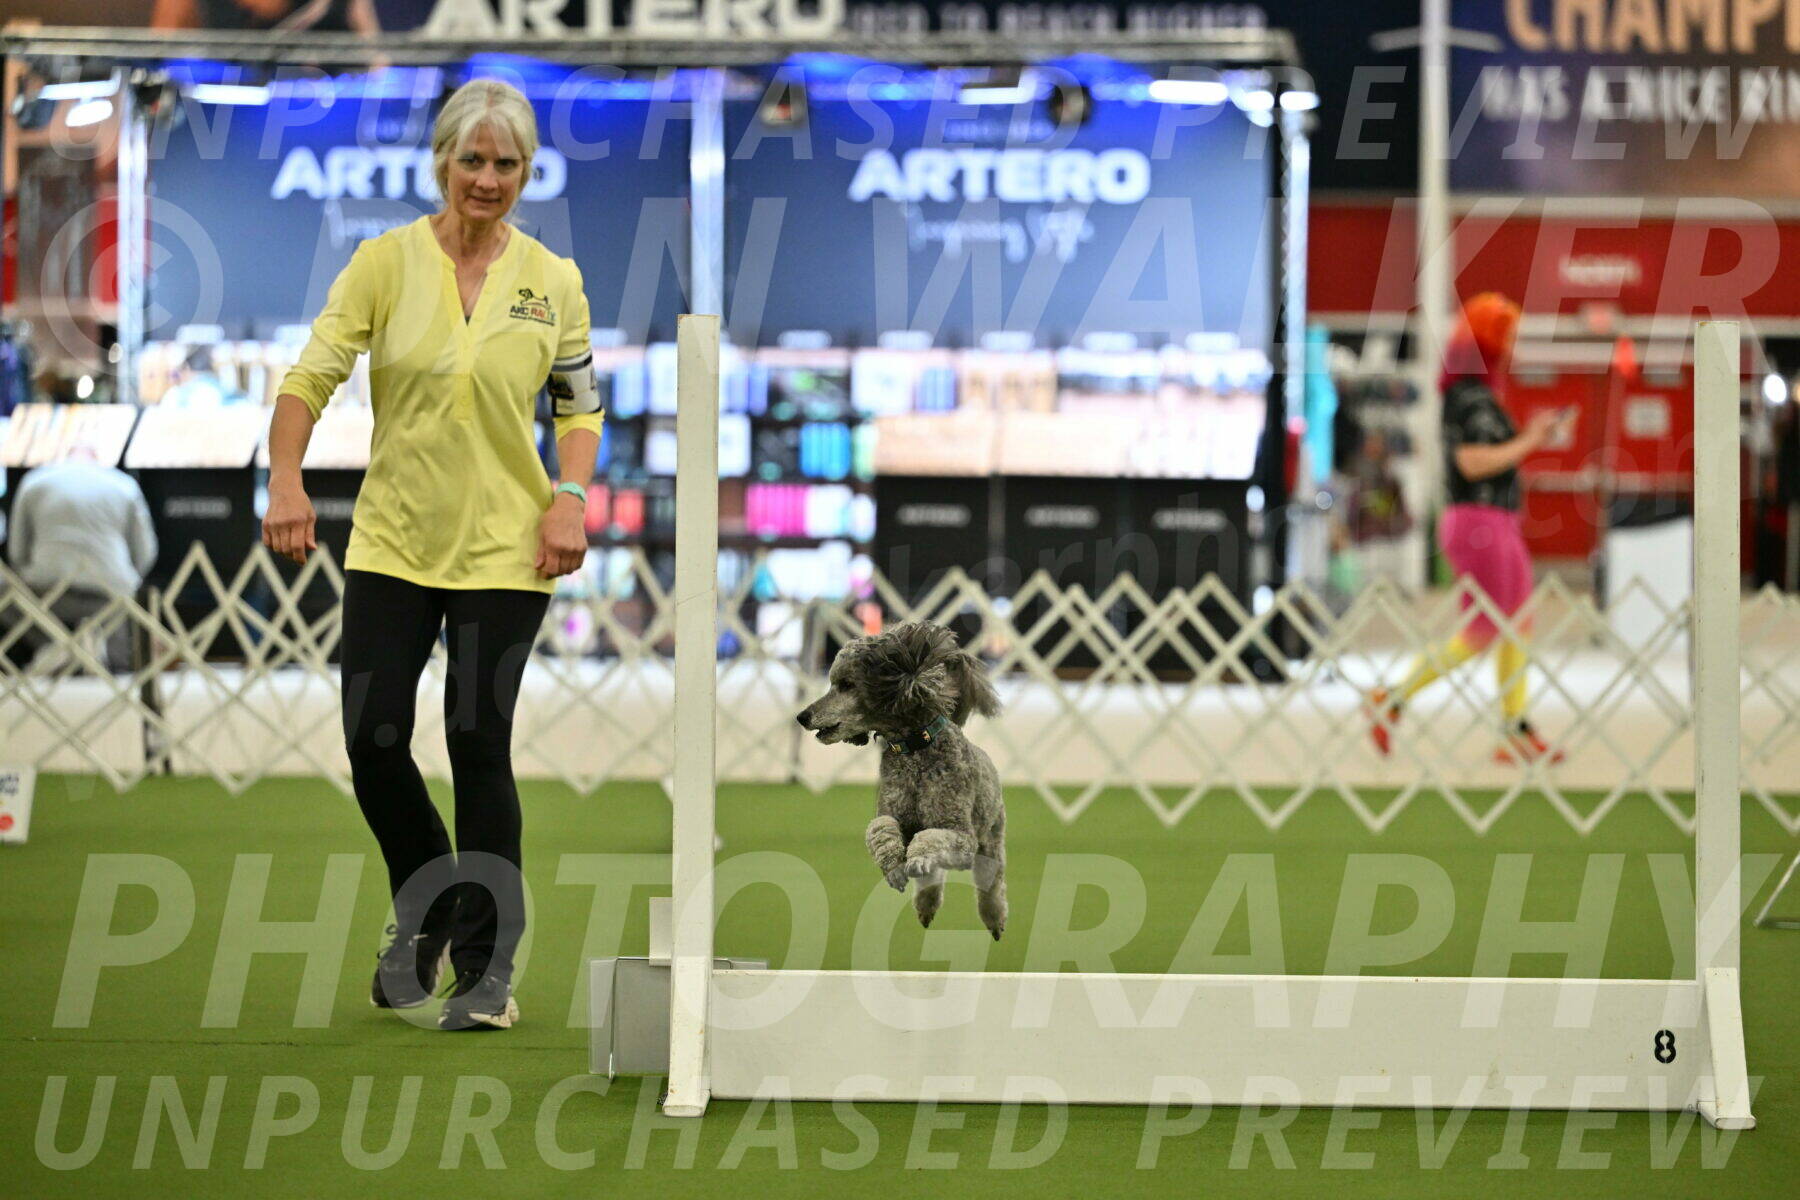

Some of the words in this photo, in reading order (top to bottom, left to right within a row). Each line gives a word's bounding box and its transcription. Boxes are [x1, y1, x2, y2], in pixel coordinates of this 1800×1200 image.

[271, 146, 567, 201] ARTO
[848, 148, 1151, 204] ARTERO
[1654, 1029, 1677, 1064] 8
